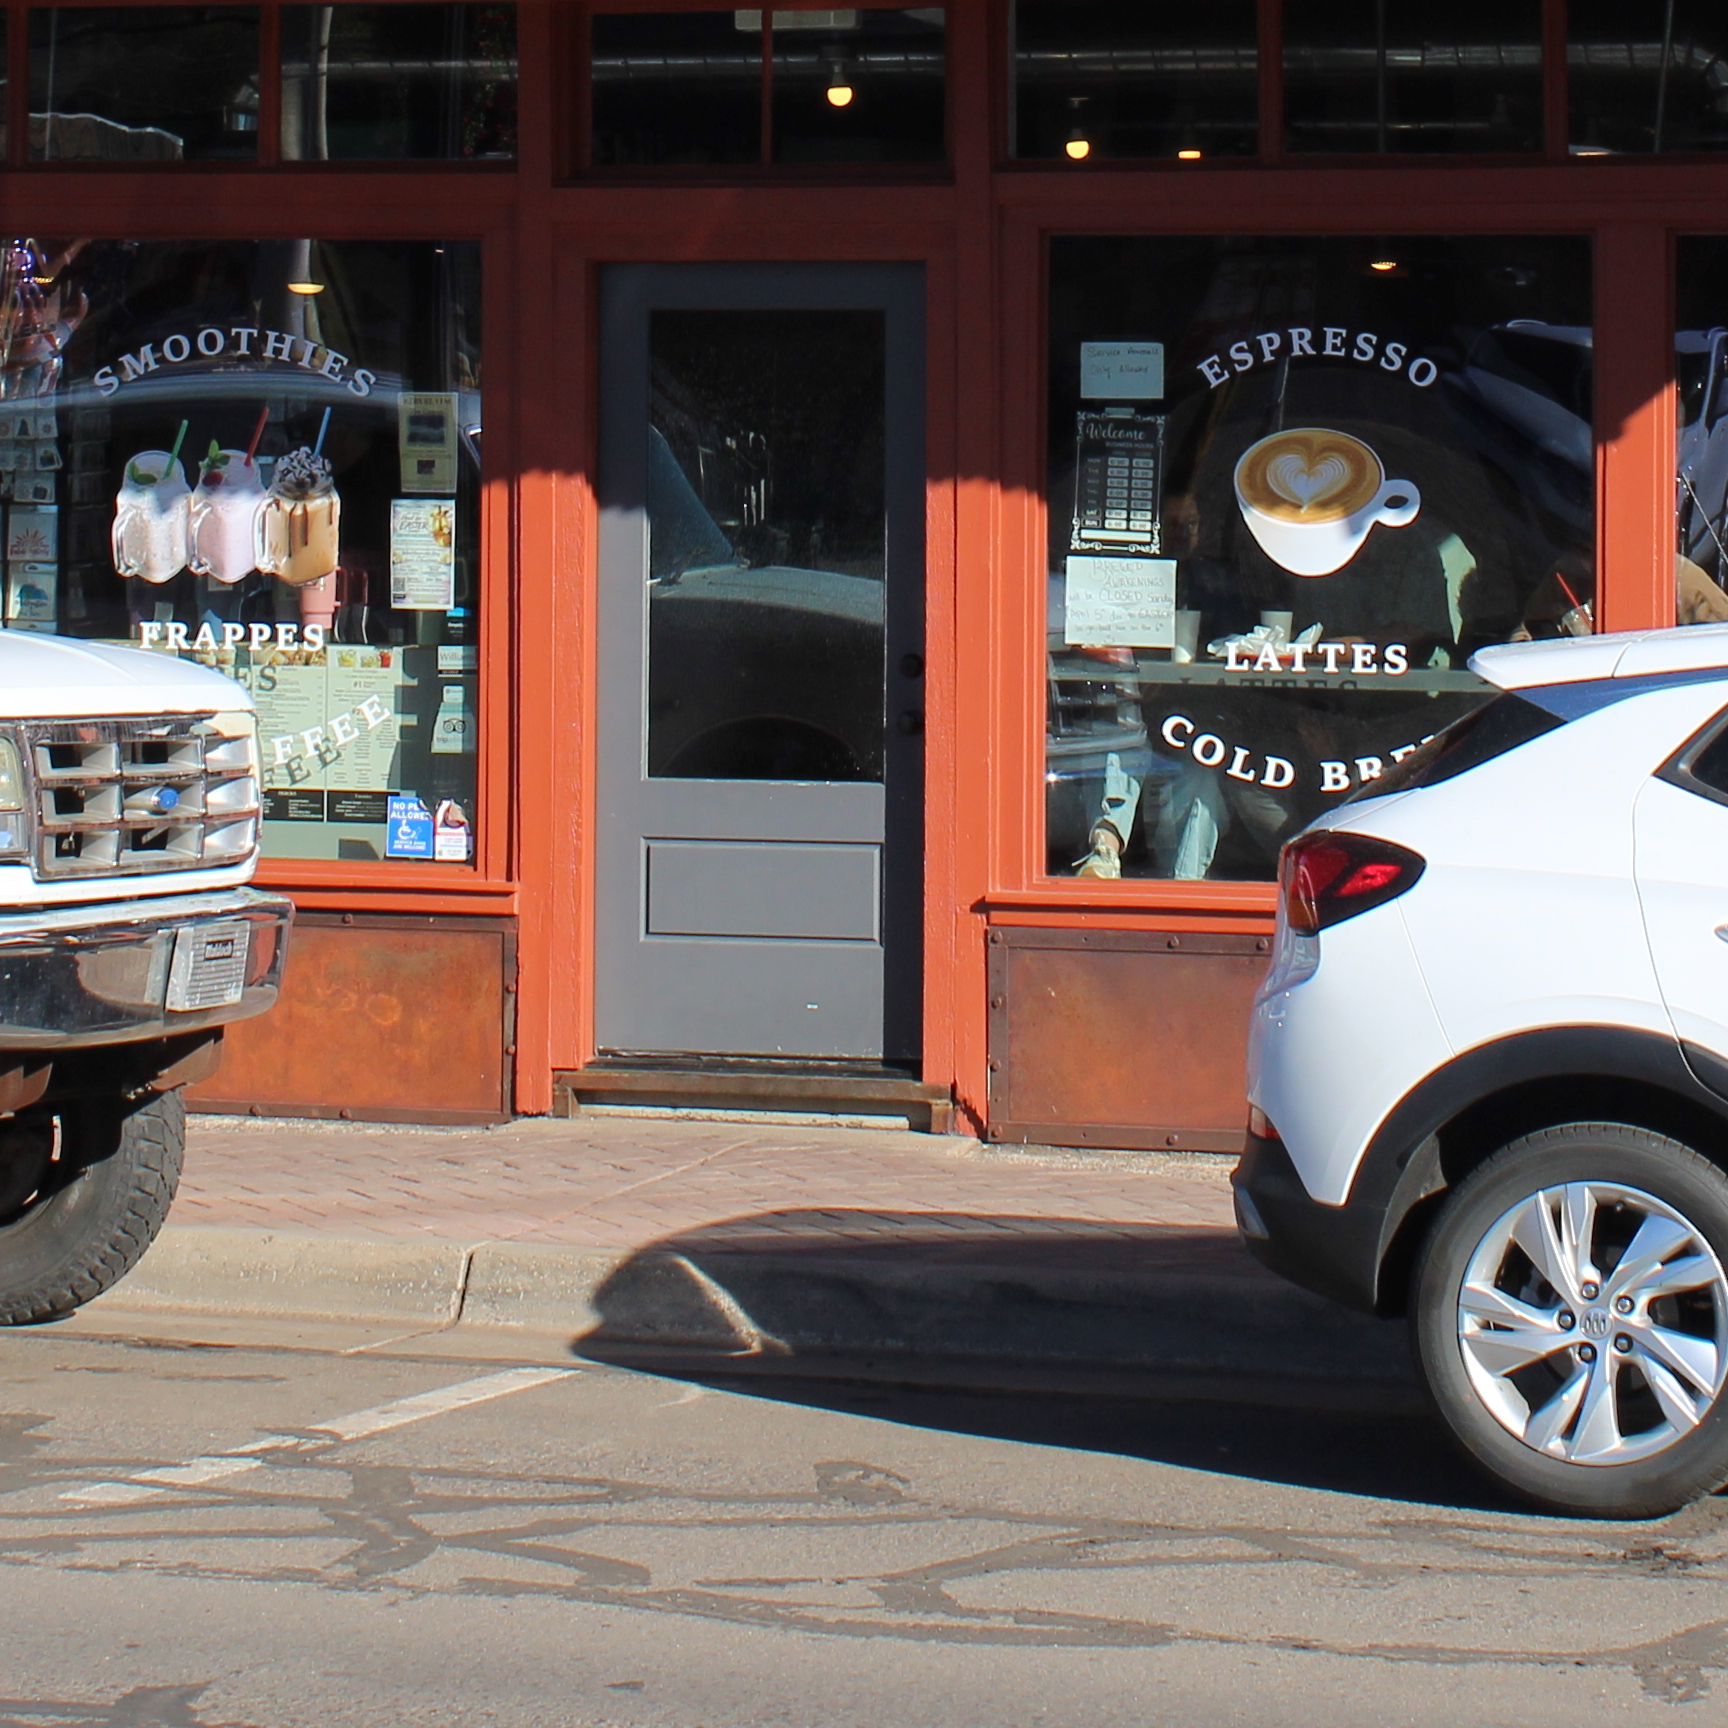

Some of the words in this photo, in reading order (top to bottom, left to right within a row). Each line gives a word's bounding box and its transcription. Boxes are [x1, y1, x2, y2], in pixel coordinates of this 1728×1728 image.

[92, 327, 377, 398] SMOOTHIES
[1196, 326, 1439, 390] ESPRESSO
[1086, 423, 1146, 440] Welcome
[138, 620, 325, 652] FRAPPES
[1224, 641, 1409, 675] LATTES
[270, 693, 391, 766] FFEE
[1160, 715, 1295, 789] COLD
[1319, 735, 1435, 792] BR
